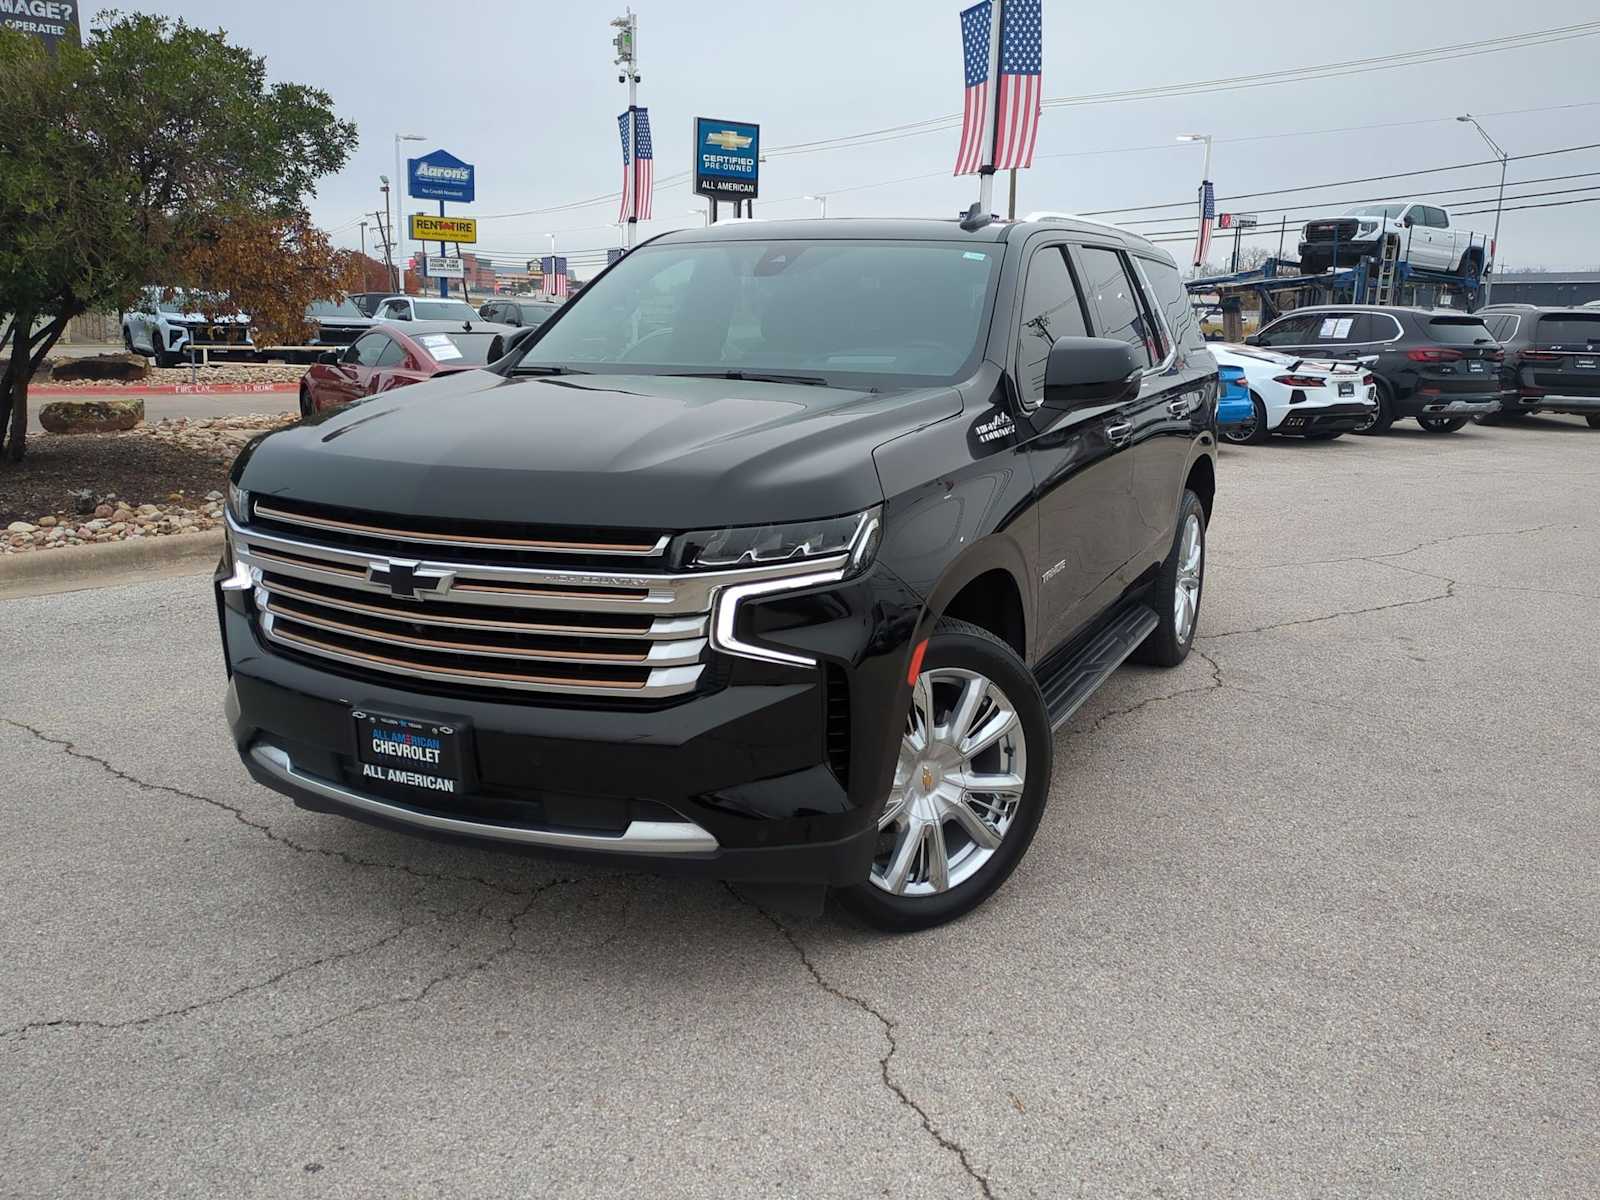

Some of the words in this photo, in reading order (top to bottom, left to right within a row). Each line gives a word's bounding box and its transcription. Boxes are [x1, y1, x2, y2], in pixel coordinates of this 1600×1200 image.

[702, 154, 754, 166] CERTIFIED
[704, 161, 752, 172] PRE-OWNED
[415, 162, 471, 180] Aaron's
[701, 180, 716, 190] ALL
[717, 181, 754, 193] AMERICAN
[372, 728, 389, 741] ALL
[391, 732, 440, 749] AMERICAN
[372, 738, 440, 764] CHEVROLET
[363, 763, 386, 780] ALL
[387, 768, 454, 793] AMERICAN
